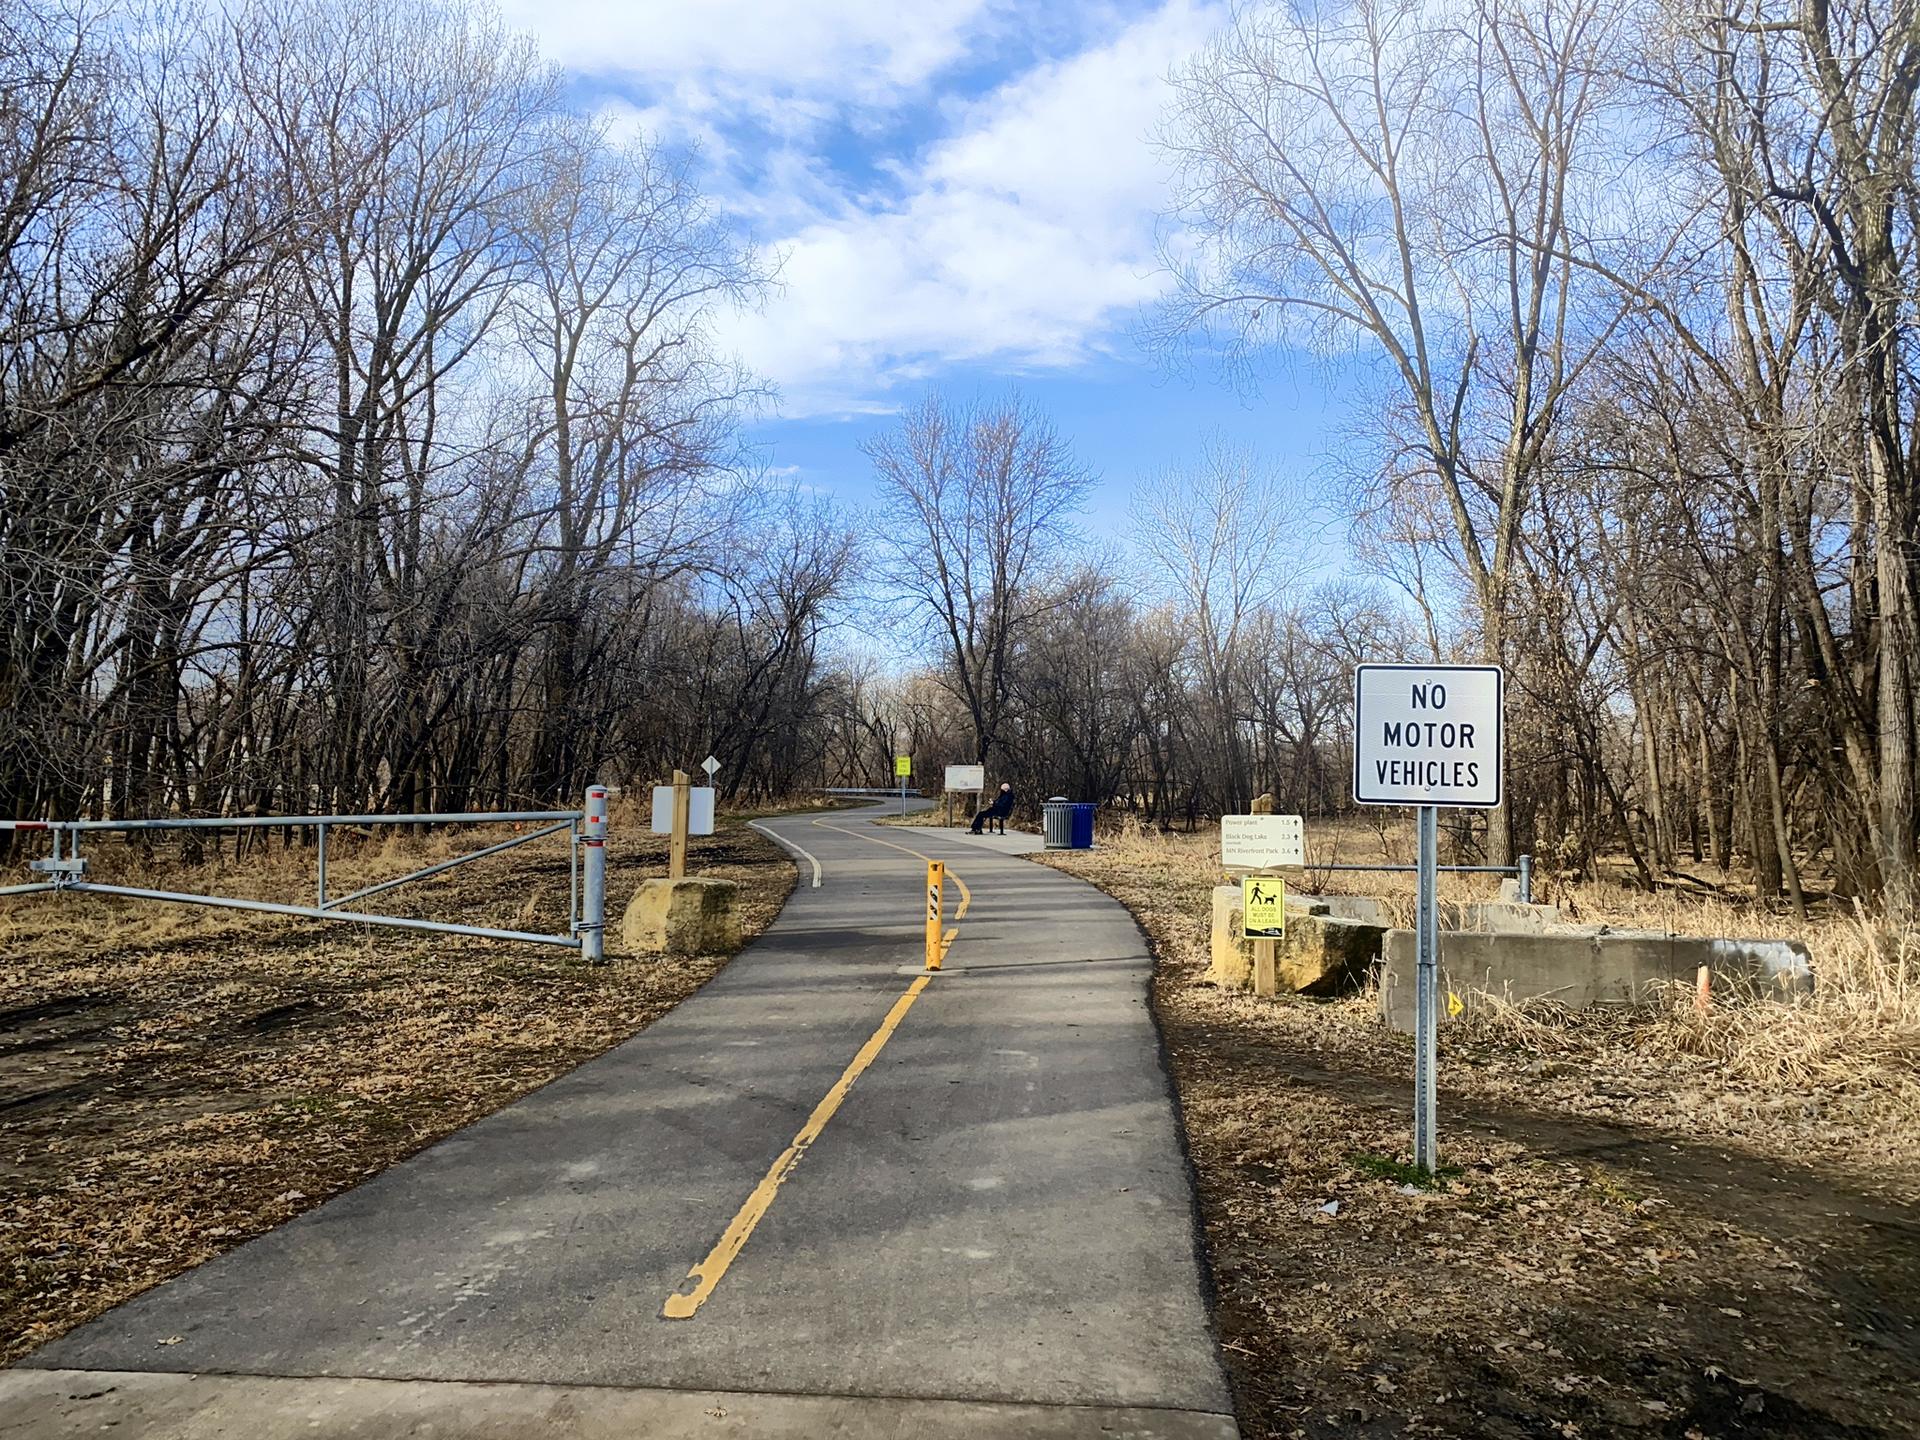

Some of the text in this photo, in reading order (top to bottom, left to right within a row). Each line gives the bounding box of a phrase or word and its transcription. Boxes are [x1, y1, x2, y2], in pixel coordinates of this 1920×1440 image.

[1412, 684, 1446, 709] NO
[1384, 722, 1475, 748] MOTOR
[1376, 760, 1479, 788] VEHICLES
[1244, 819, 1258, 827] plant
